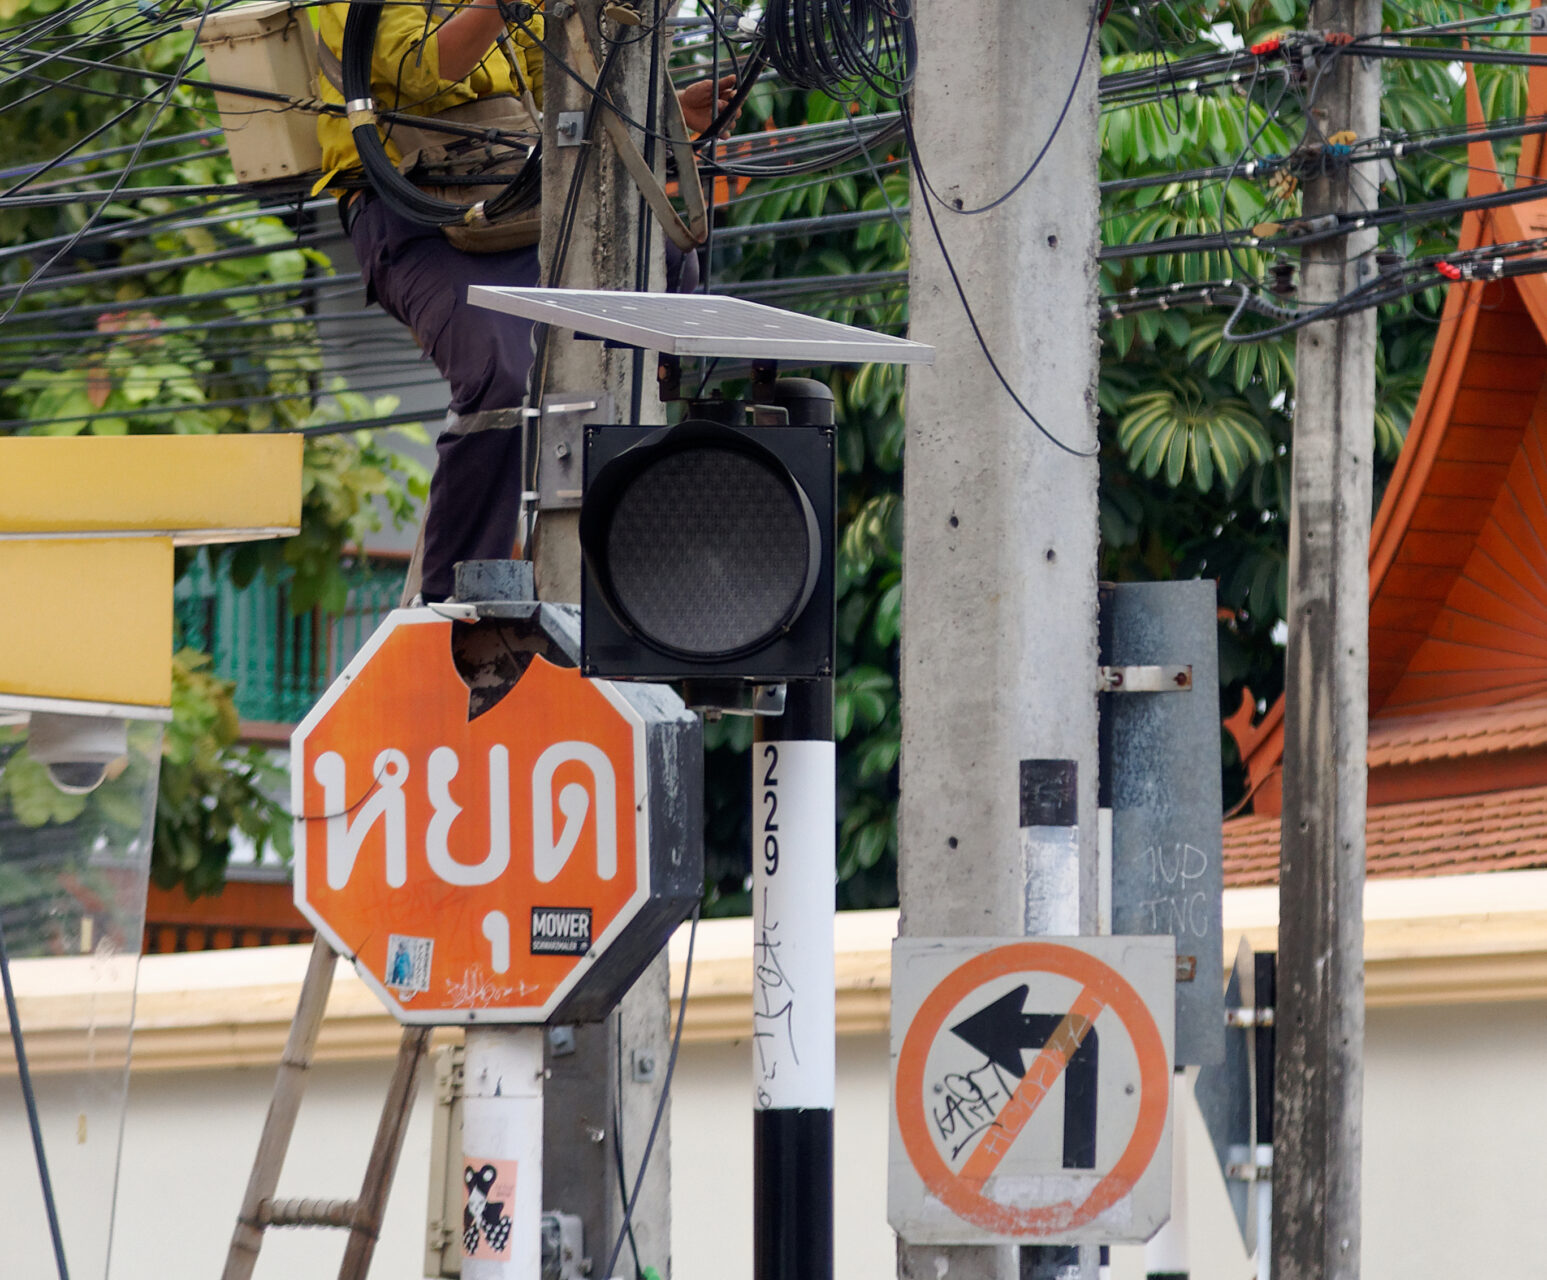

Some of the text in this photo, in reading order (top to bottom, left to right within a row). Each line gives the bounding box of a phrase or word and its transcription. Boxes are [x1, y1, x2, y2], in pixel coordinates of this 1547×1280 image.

[313, 740, 618, 974] หยุด
[763, 744, 780, 877] 229
[532, 913, 590, 937] MOWER
